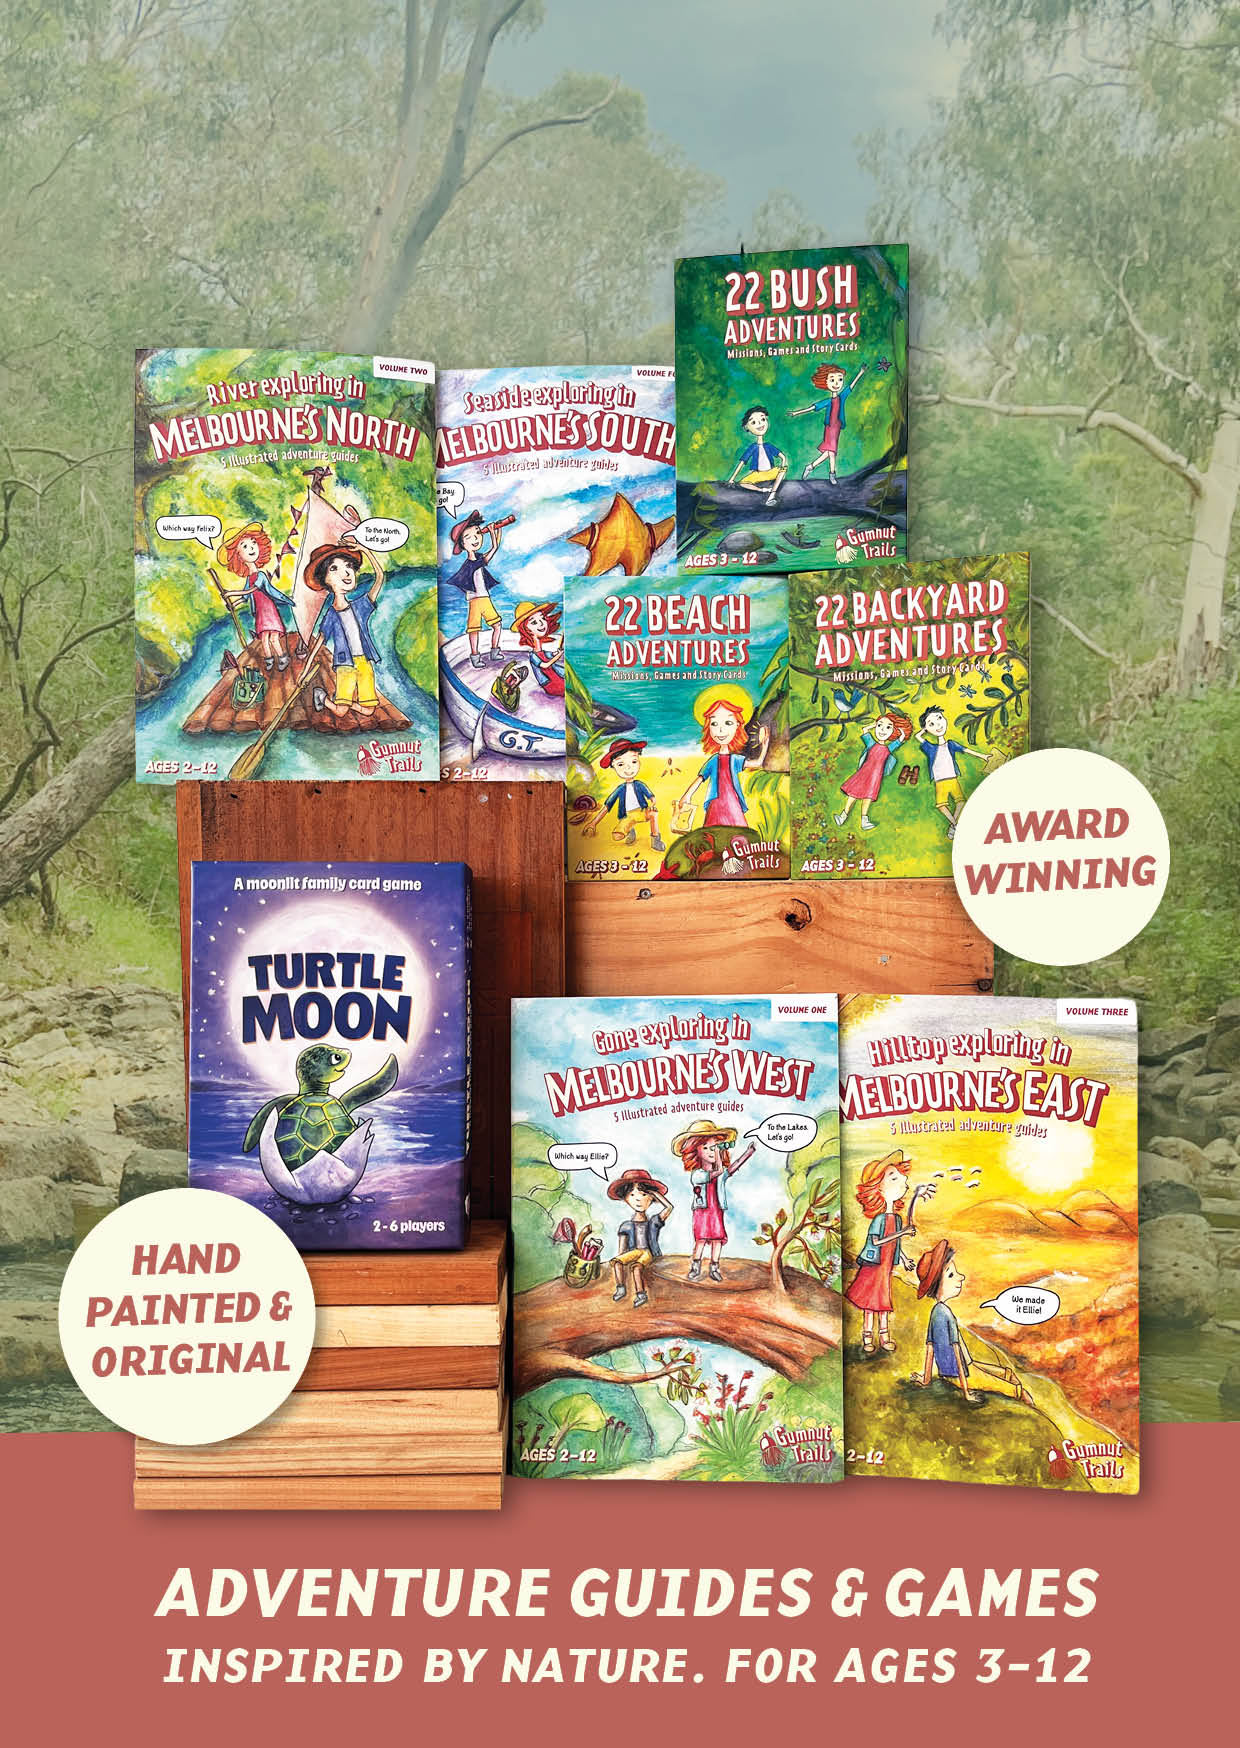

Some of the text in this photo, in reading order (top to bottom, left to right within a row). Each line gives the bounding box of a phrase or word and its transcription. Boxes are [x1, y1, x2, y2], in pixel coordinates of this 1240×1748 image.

[724, 264, 859, 316] 22 BUSH
[724, 312, 860, 346] ADVENTURES
[727, 342, 858, 359] Missions, Games and Story Cards
[379, 363, 428, 376] VOLUME TWO
[636, 369, 666, 378] VOLUME
[206, 370, 366, 407] River exploring in
[463, 380, 636, 414] Seaside exploring in
[149, 404, 420, 463] MELBOURNE'S NORTH
[585, 410, 676, 467] SOUTH
[221, 448, 359, 468] 5 Illustrated adventure guides
[483, 456, 619, 475] 5 Illustrated adventure guides
[438, 496, 449, 505] go!
[442, 487, 455, 496] Bay
[162, 524, 215, 534] Which way Felix?
[373, 526, 382, 534] the
[365, 535, 390, 544] Let's go!
[846, 525, 897, 560] Gumnut Trails
[685, 553, 719, 568] AGES
[719, 552, 729, 566] 3
[742, 551, 759, 566] 12
[604, 594, 751, 636] 22 BEACH
[815, 579, 1009, 631] 22 BACKYARD
[815, 616, 1008, 669] ADVENTURES
[606, 639, 750, 668] ADVENTURES
[611, 669, 746, 682] Missions, Games and Story Cards
[833, 662, 986, 682] Missions, Games and Story Cards
[369, 739, 422, 774] Gumnut Trails
[145, 760, 180, 774] AGES
[732, 839, 779, 870] Gumnut Trails
[575, 860, 609, 874] AGES
[609, 860, 619, 873] 3
[632, 860, 648, 874] 12
[801, 859, 835, 873] AGES
[835, 858, 846, 872] 3
[858, 858, 875, 871] 12
[234, 876, 422, 893] A moonlit family card game
[247, 952, 406, 993] TURTLE
[242, 991, 412, 1044] MOON
[778, 1005, 827, 1014] VOLUME ONE
[1066, 1007, 1129, 1016] VOLUME THREE
[592, 1012, 752, 1055] Gone exploring in
[866, 1028, 1072, 1067] Hilltop exploring in
[543, 1049, 815, 1118] MELBOURNE'S WEST
[839, 1067, 1110, 1128] MELBOURNE'S EAST
[613, 1101, 744, 1123] 5 Illustrated adventure guides
[767, 1123, 775, 1131] To
[776, 1123, 786, 1131] the
[890, 1118, 1048, 1139] 5 Illustrated adventure guides
[767, 1133, 794, 1143] Let's go!
[554, 1152, 609, 1162] Which way Ellie?
[372, 1220, 381, 1233] 2
[389, 1219, 399, 1233] 6
[400, 1219, 446, 1234] players
[1011, 1295, 1045, 1305] We made
[1015, 1305, 1042, 1315] it Ellie!
[774, 1425, 833, 1463] Gumnut Trails
[520, 1448, 557, 1463] AGES
[1062, 1439, 1124, 1480] Gumnut Trails
